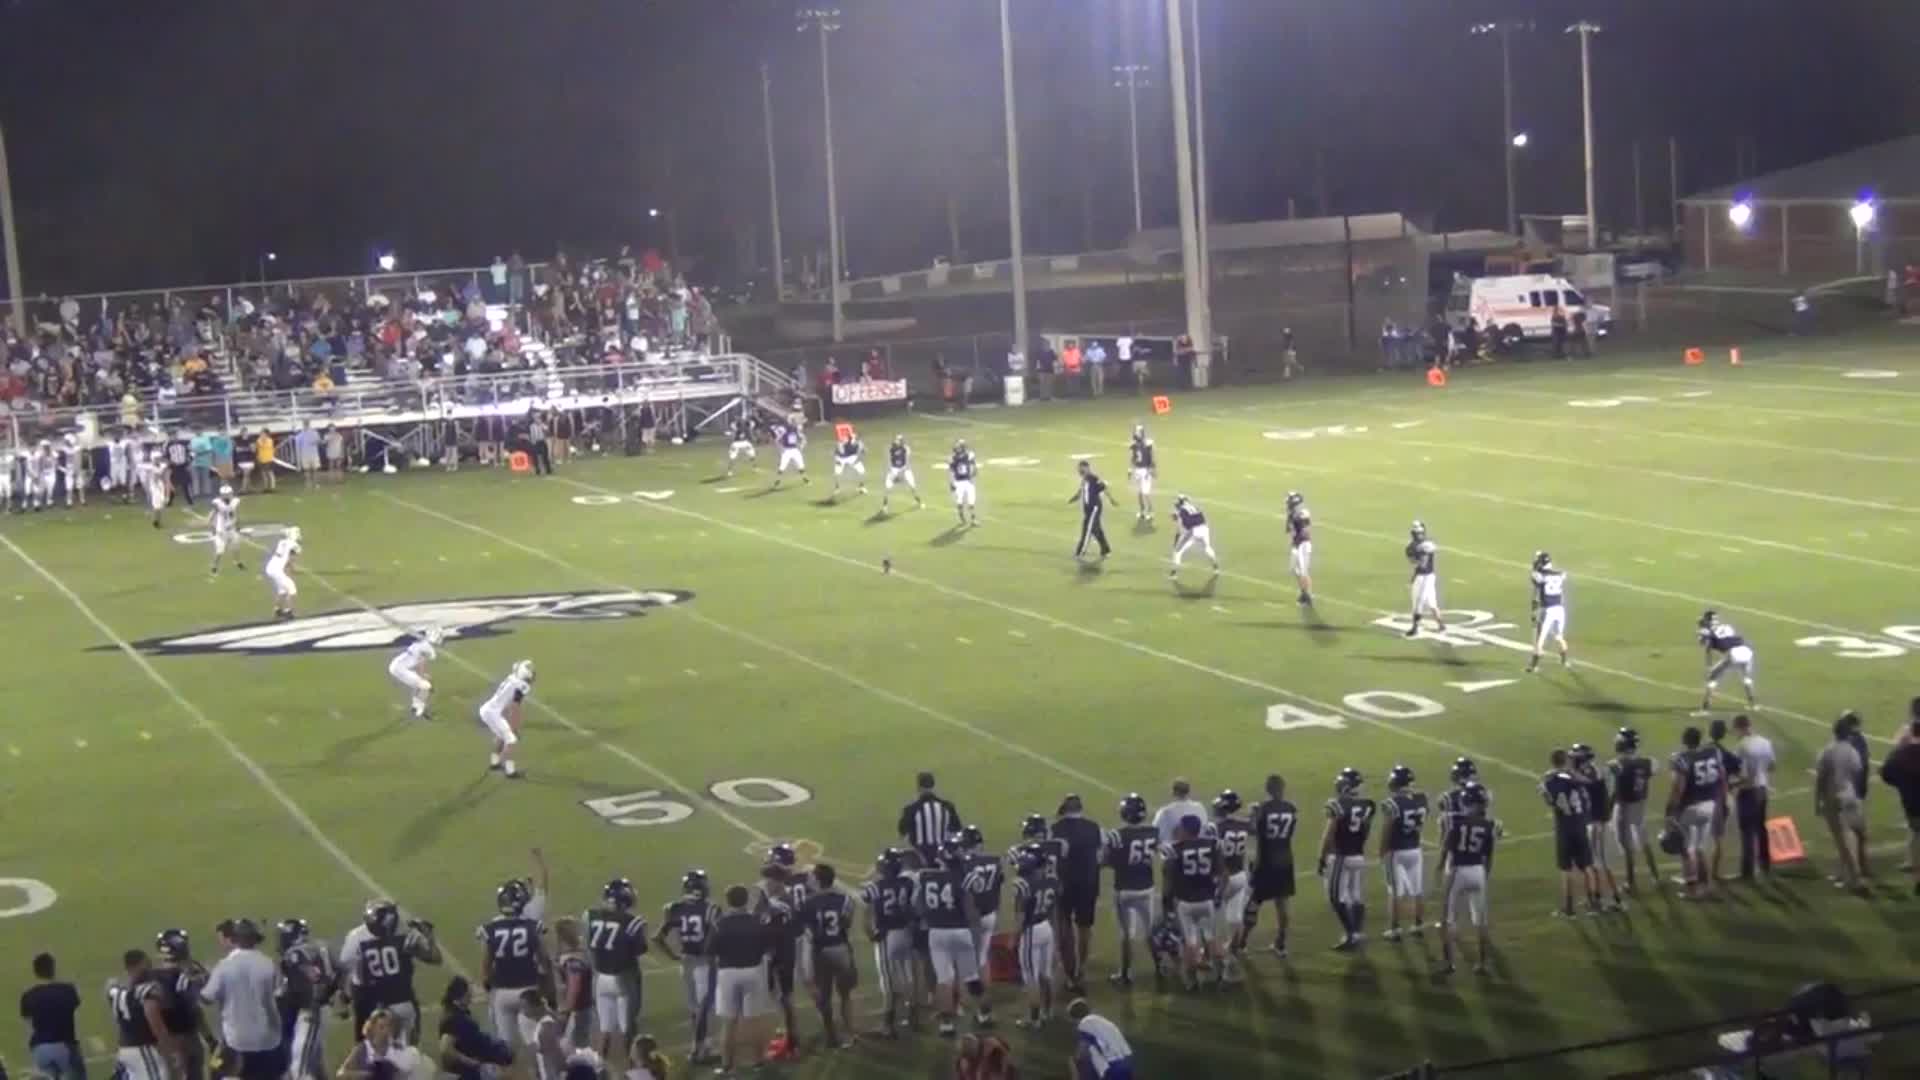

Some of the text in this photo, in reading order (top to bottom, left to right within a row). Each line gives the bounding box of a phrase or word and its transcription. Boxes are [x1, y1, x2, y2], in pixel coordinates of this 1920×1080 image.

[1266, 812, 1293, 839] 57
[1459, 824, 1486, 853] 15
[1183, 847, 1212, 876] 55
[925, 881, 955, 910] 64
[494, 927, 529, 957] 72
[590, 920, 620, 950] 77
[366, 945, 400, 977] 20
